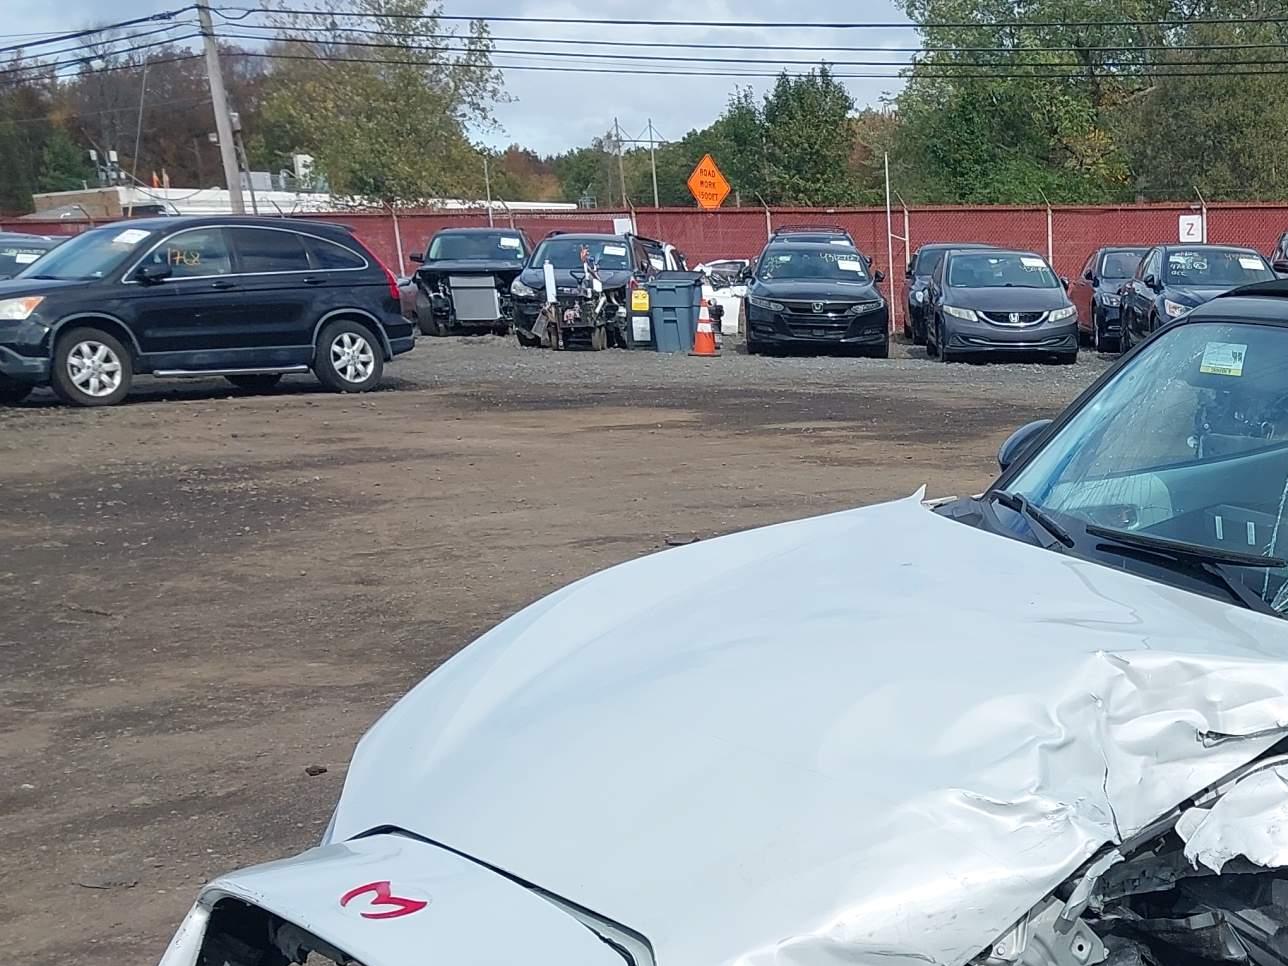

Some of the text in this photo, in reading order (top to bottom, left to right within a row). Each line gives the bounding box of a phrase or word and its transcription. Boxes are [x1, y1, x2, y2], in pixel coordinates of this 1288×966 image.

[699, 168, 715, 178] ROAD
[699, 180, 716, 189] WORK
[1186, 222, 1196, 236] Z
